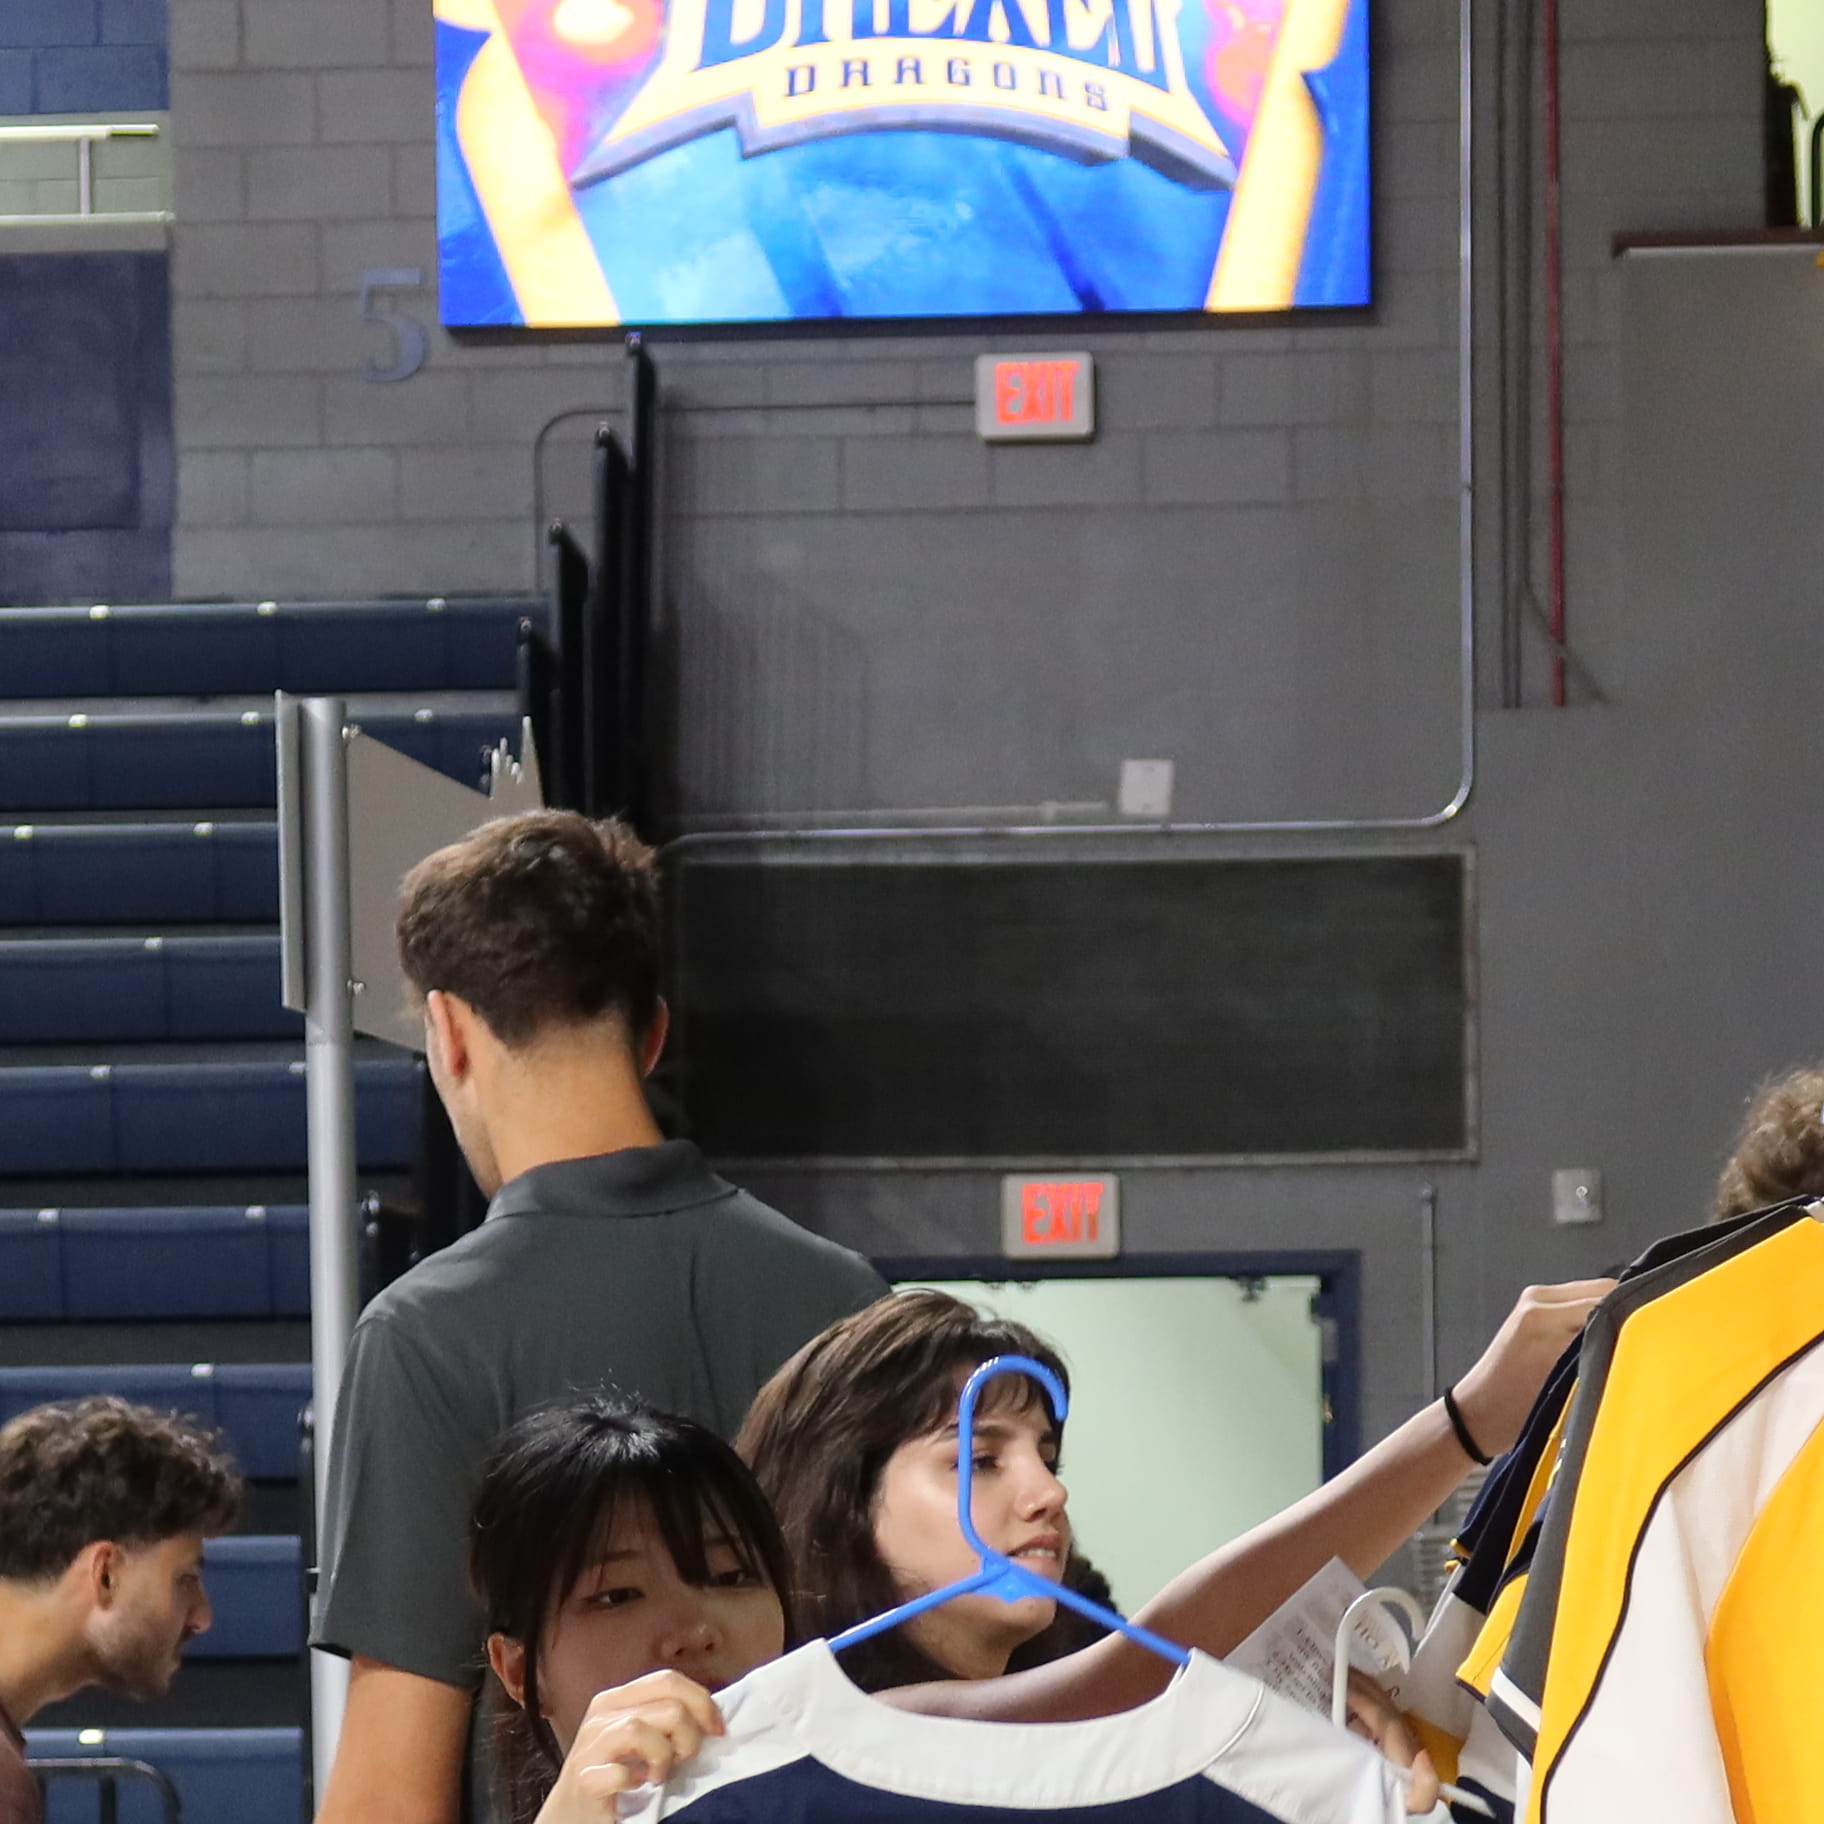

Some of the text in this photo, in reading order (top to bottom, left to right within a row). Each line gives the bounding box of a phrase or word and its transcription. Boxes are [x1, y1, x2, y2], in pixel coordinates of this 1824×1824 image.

[784, 55, 1110, 113] DRAGONS
[360, 266, 427, 384] 5
[994, 360, 1081, 424] EXIT
[1021, 1182, 1105, 1245] EXIT
